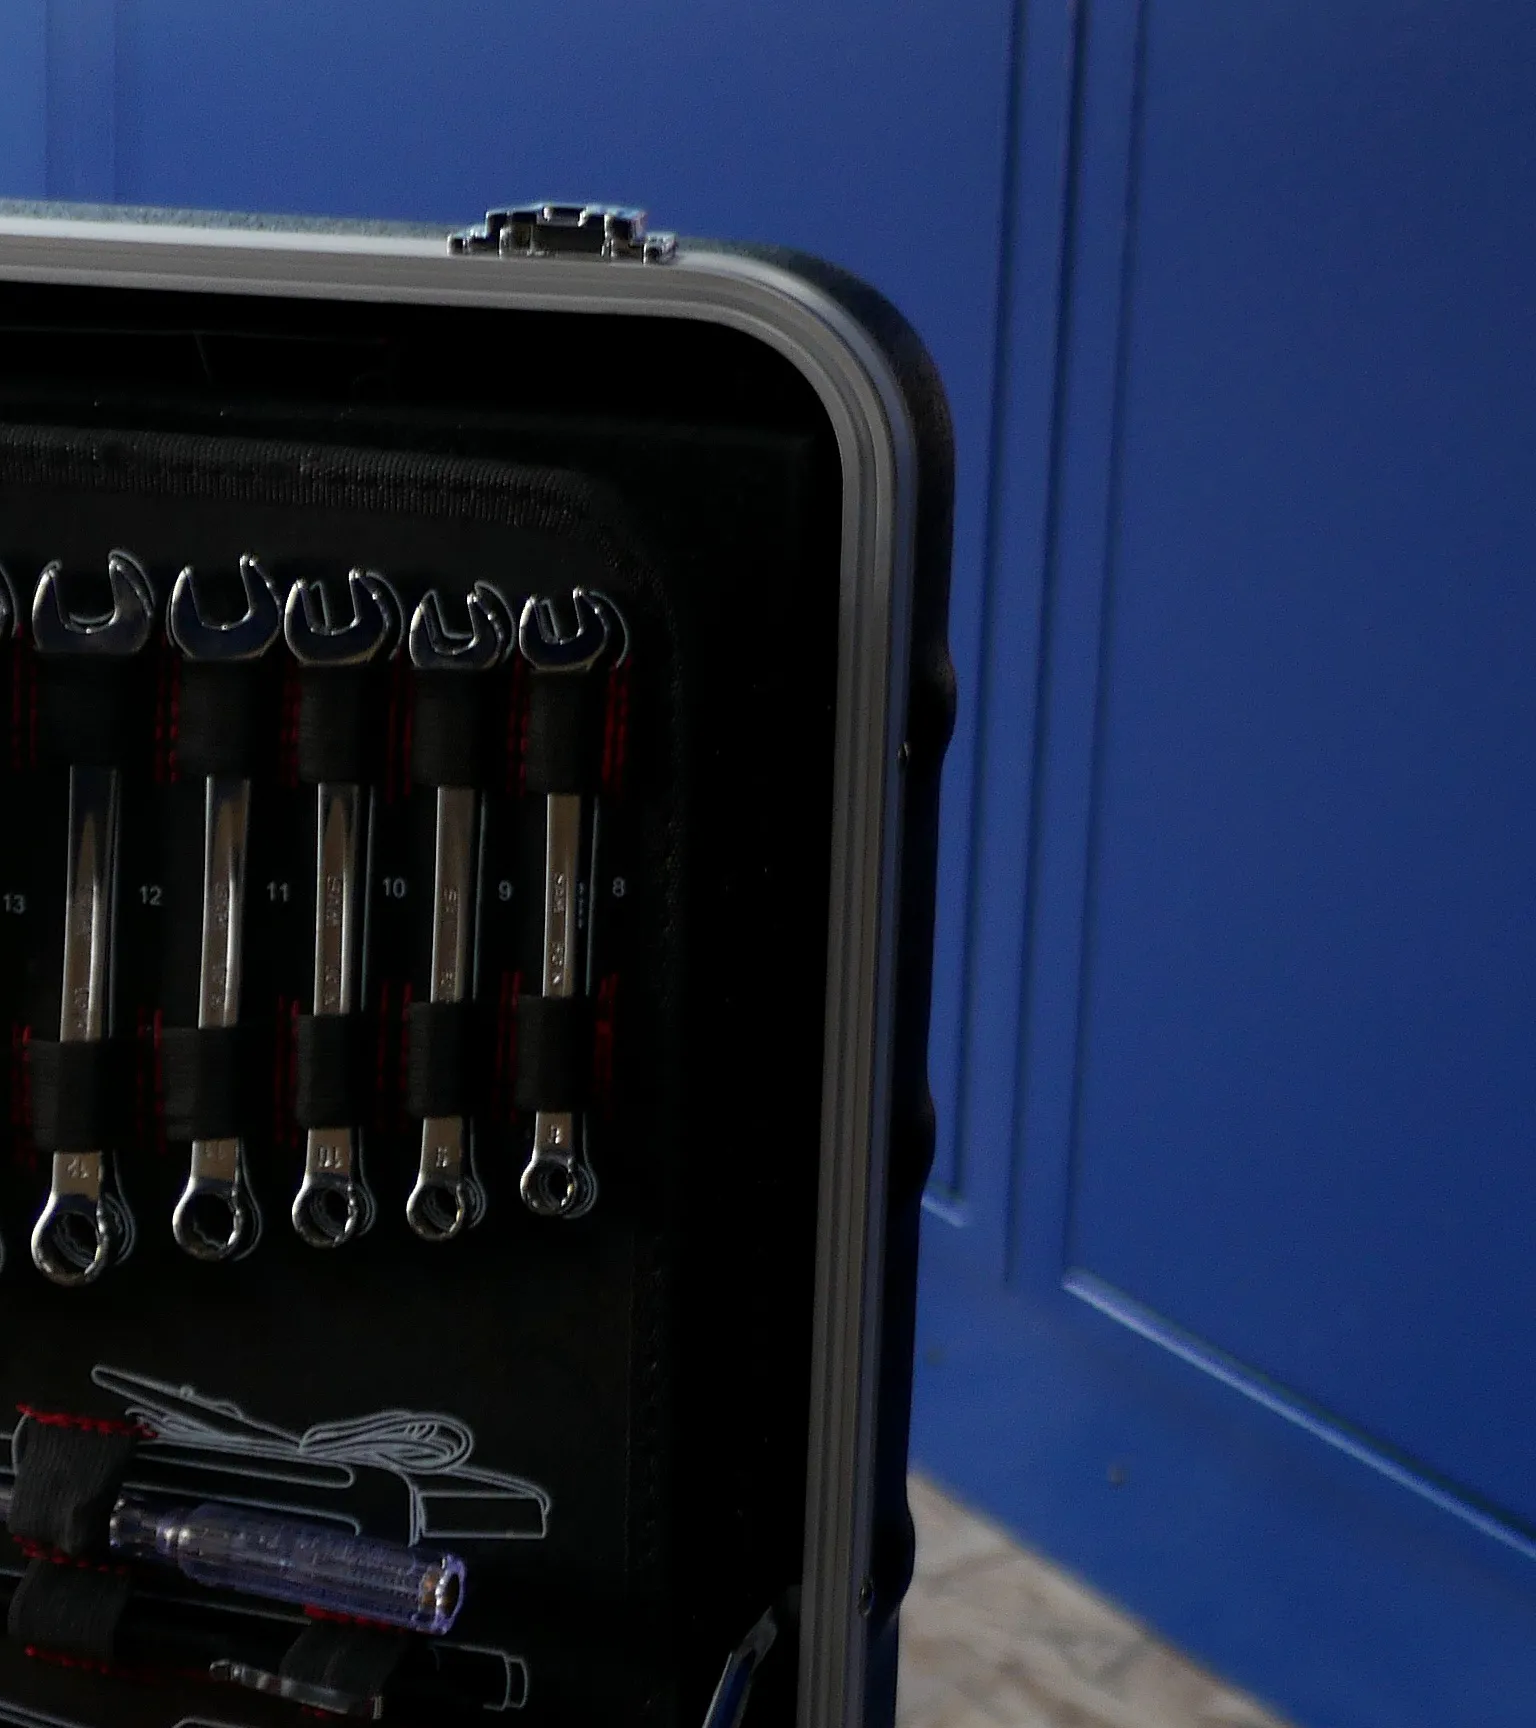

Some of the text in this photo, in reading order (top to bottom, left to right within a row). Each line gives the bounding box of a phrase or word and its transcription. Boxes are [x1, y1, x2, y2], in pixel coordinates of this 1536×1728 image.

[139, 883, 164, 907] 12
[266, 879, 292, 903] 11
[382, 876, 408, 899] 10
[497, 879, 514, 902] 9
[611, 876, 626, 898] 8
[2, 893, 27, 916] 13
